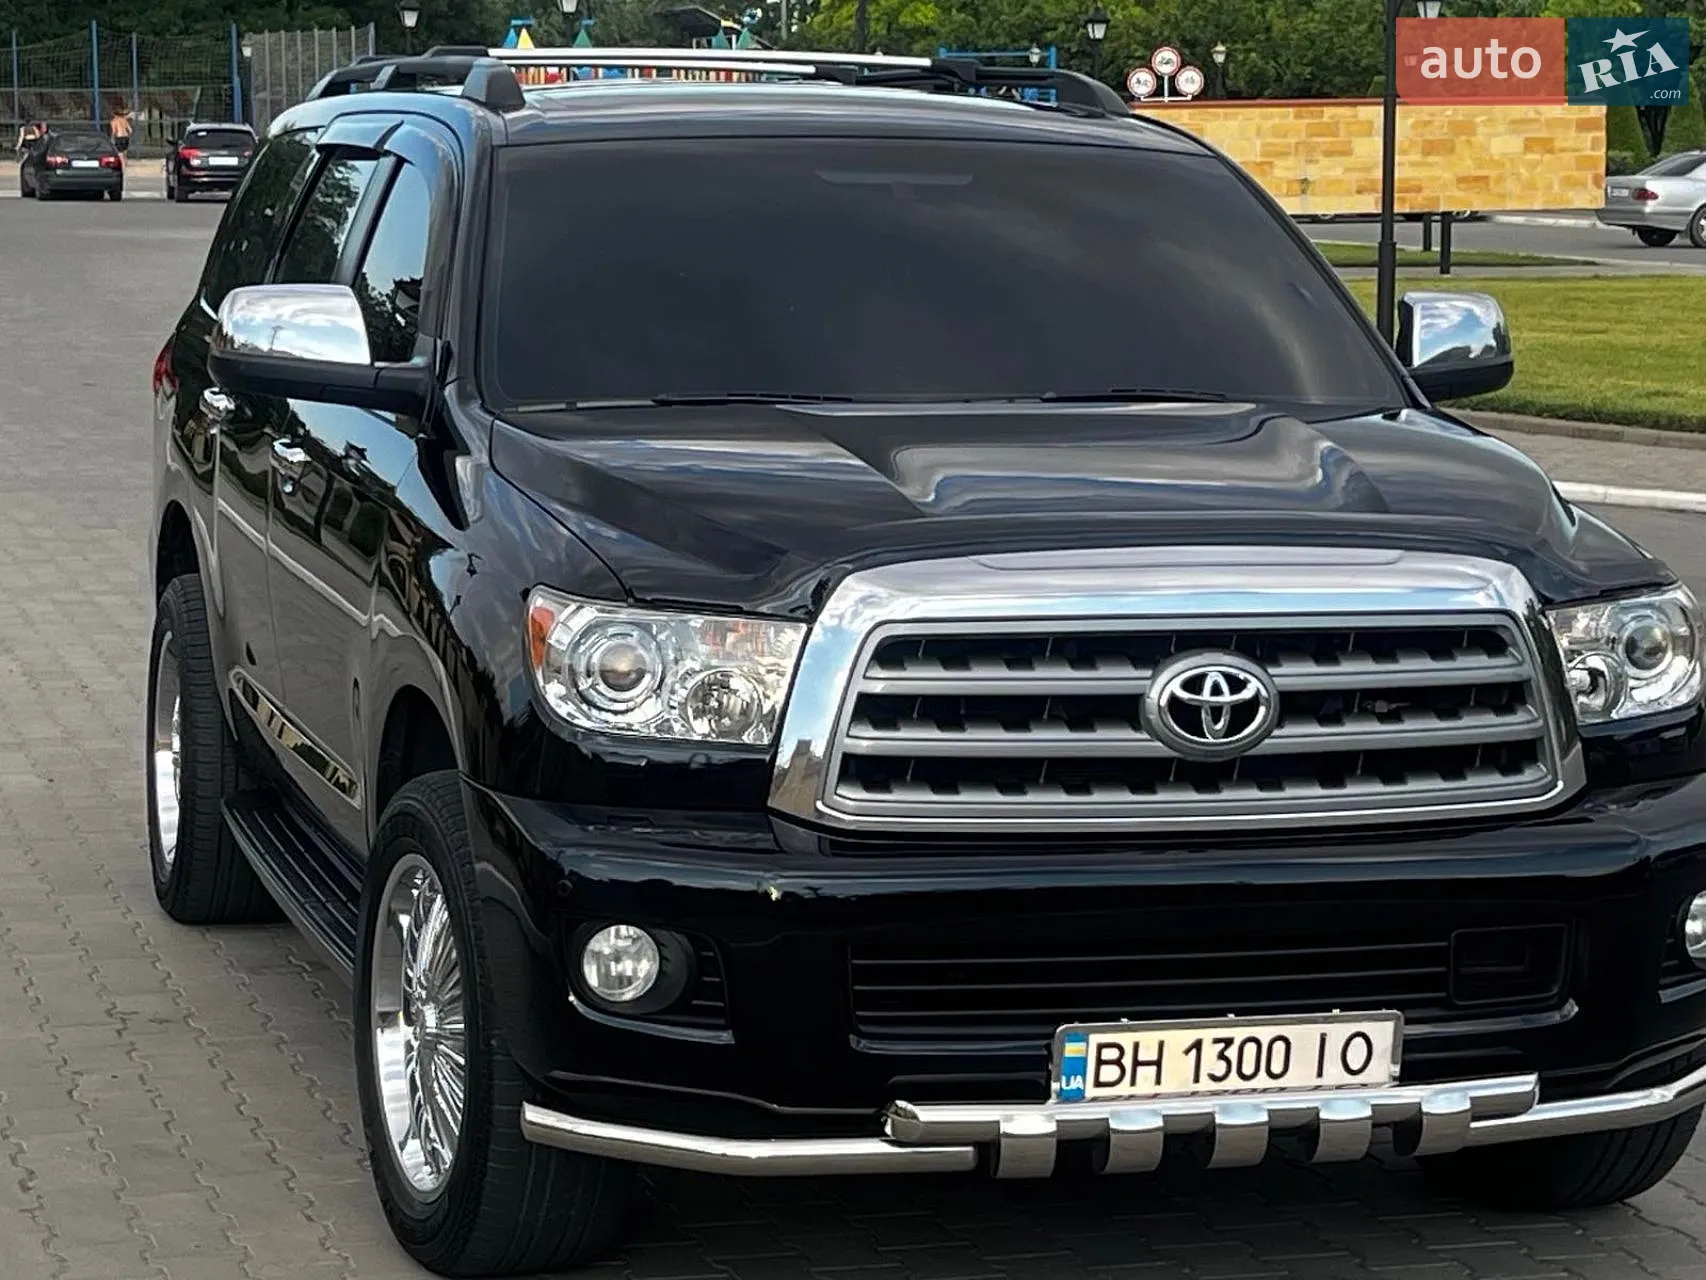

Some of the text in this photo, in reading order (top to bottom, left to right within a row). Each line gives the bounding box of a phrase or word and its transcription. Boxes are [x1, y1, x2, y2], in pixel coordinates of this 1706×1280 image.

[1093, 1040, 1165, 1088] BH
[1183, 1035, 1291, 1084] 1300
[1061, 1075, 1084, 1090] UA
